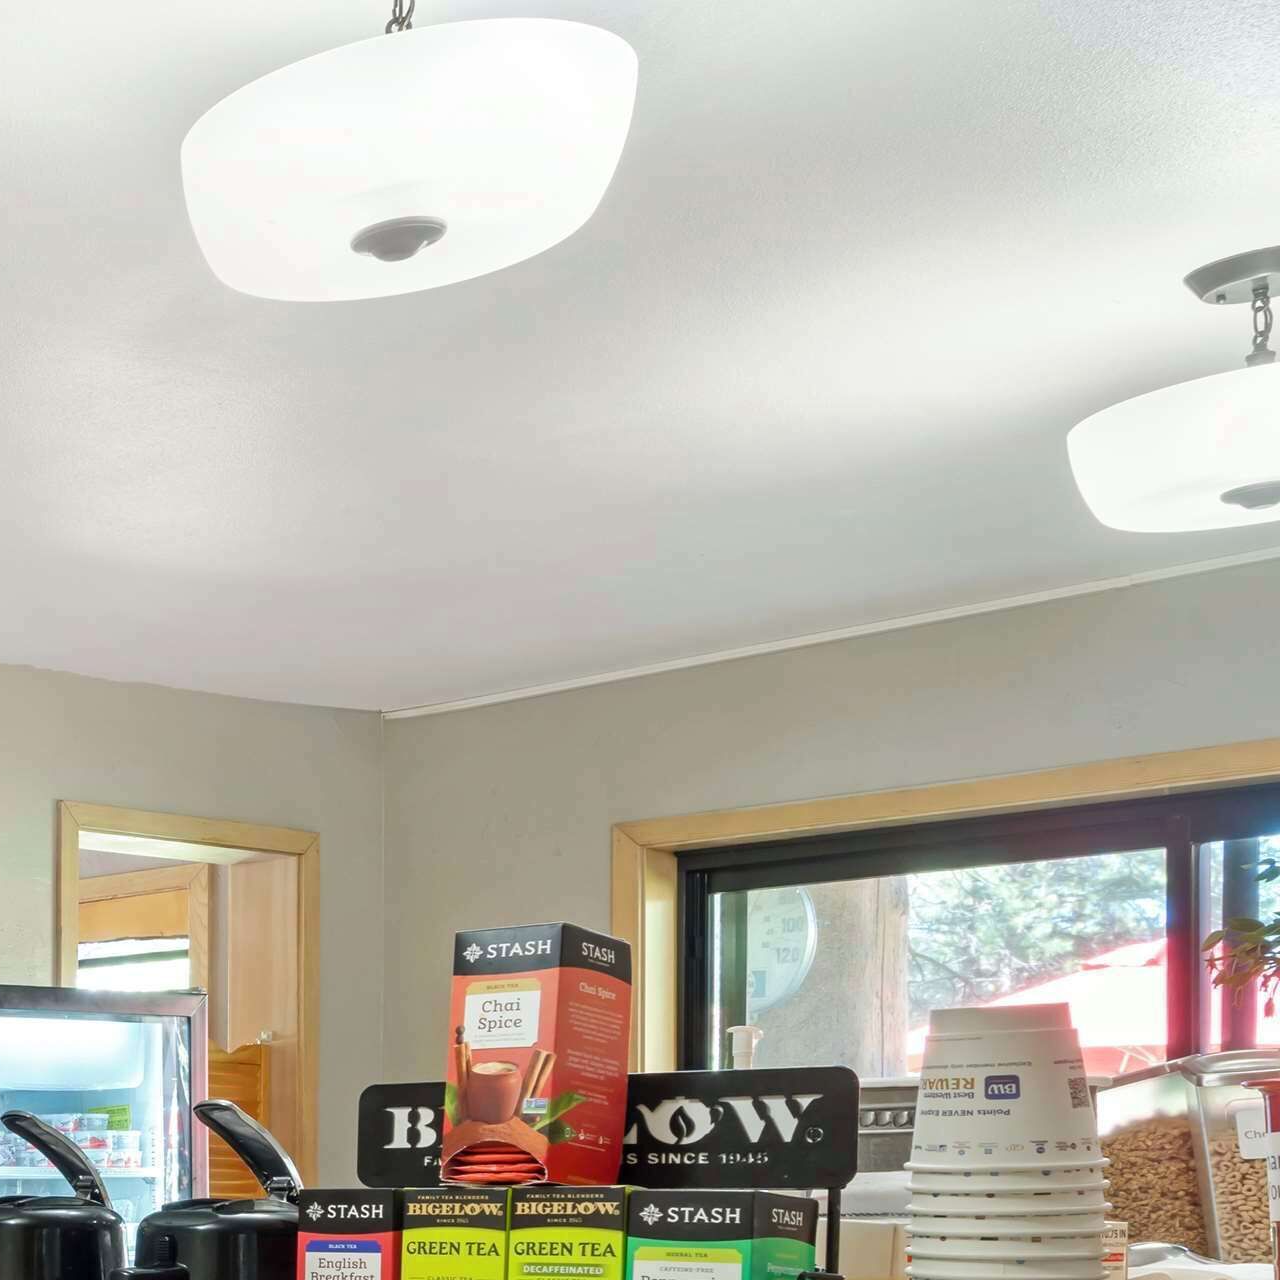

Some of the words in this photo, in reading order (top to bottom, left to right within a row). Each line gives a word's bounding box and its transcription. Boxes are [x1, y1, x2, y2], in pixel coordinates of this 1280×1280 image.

[486, 939, 552, 959] STASH
[581, 942, 615, 964] STASH
[578, 982, 597, 995] Chai
[598, 987, 617, 1000] Spice
[481, 998, 521, 1013] Chai
[478, 1017, 523, 1032] Spice
[987, 1083, 1017, 1096] BW
[941, 1108, 974, 1117] NEVER
[647, 1151, 709, 1165] SINCE
[717, 1152, 768, 1165] 1945
[326, 1204, 384, 1219] STASH
[406, 1202, 503, 1217] BIGELOW
[514, 1201, 620, 1216] BIGELOW
[666, 1207, 741, 1224] STASH
[771, 1208, 804, 1226] STASH
[406, 1241, 461, 1256] GREEN
[465, 1241, 500, 1257] TEA
[514, 1241, 574, 1257] GREEN
[578, 1242, 617, 1258] TEA
[318, 1257, 368, 1271] English
[522, 1264, 604, 1275] DECAFFEINATED
